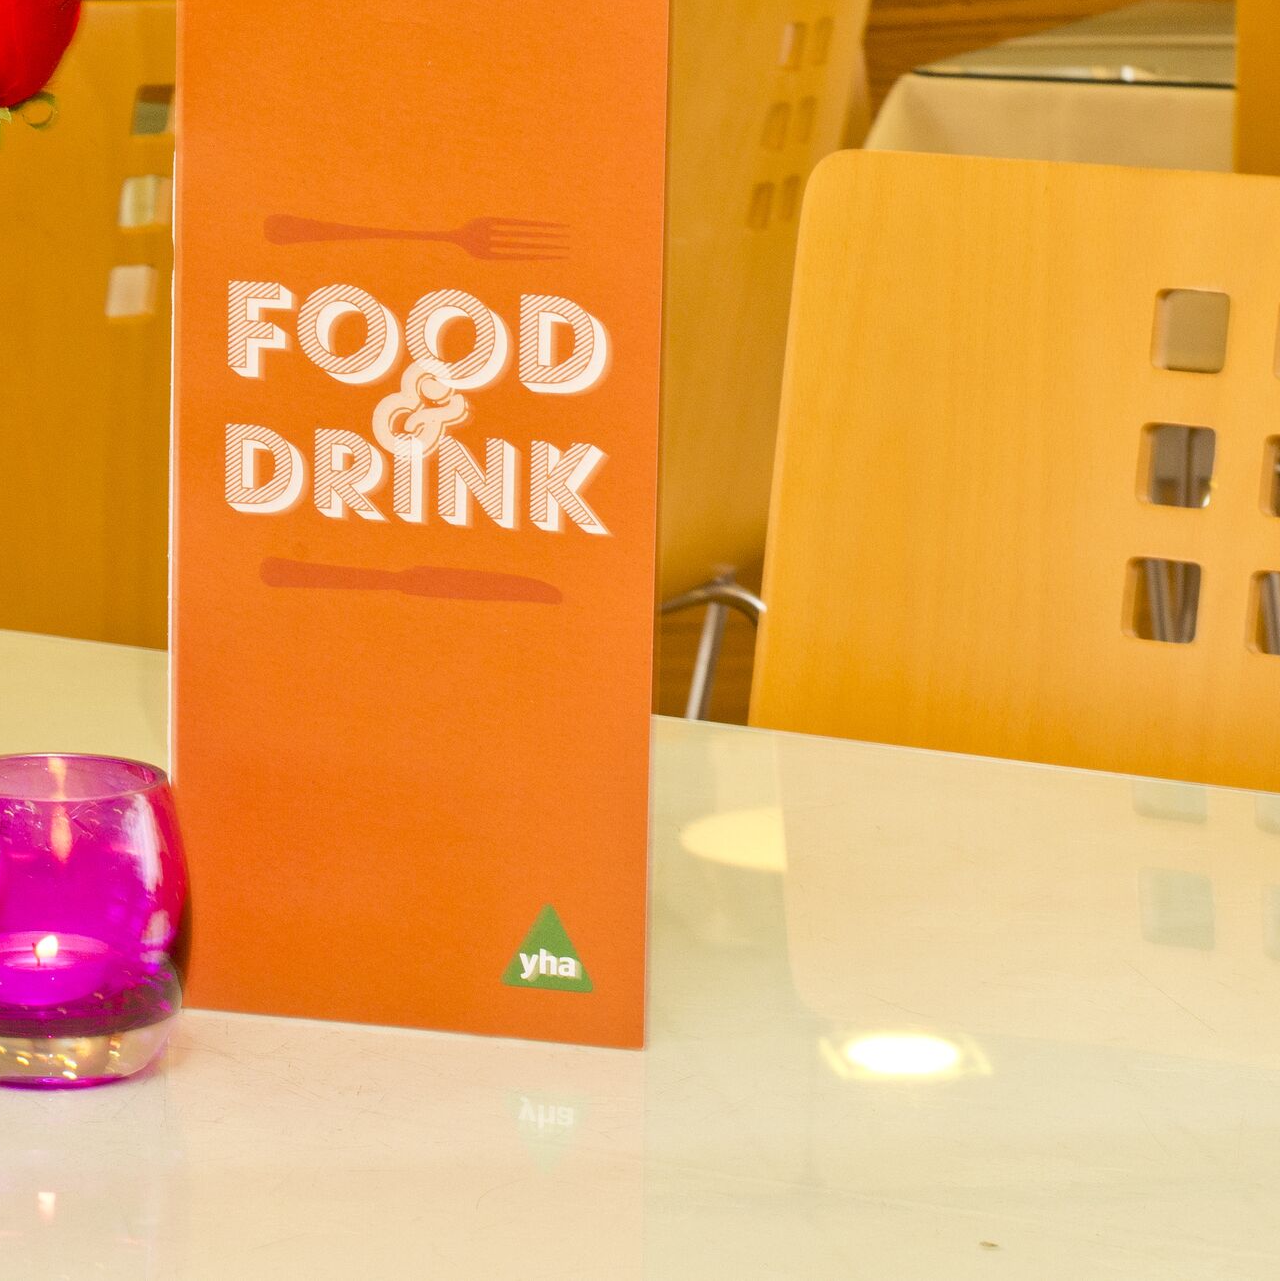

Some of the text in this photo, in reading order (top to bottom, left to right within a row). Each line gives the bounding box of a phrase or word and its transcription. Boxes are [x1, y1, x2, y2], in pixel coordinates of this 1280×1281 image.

[226, 279, 611, 395] FOOD
[371, 356, 474, 461] &
[224, 421, 614, 537] DRINK
[519, 947, 582, 982] yha
